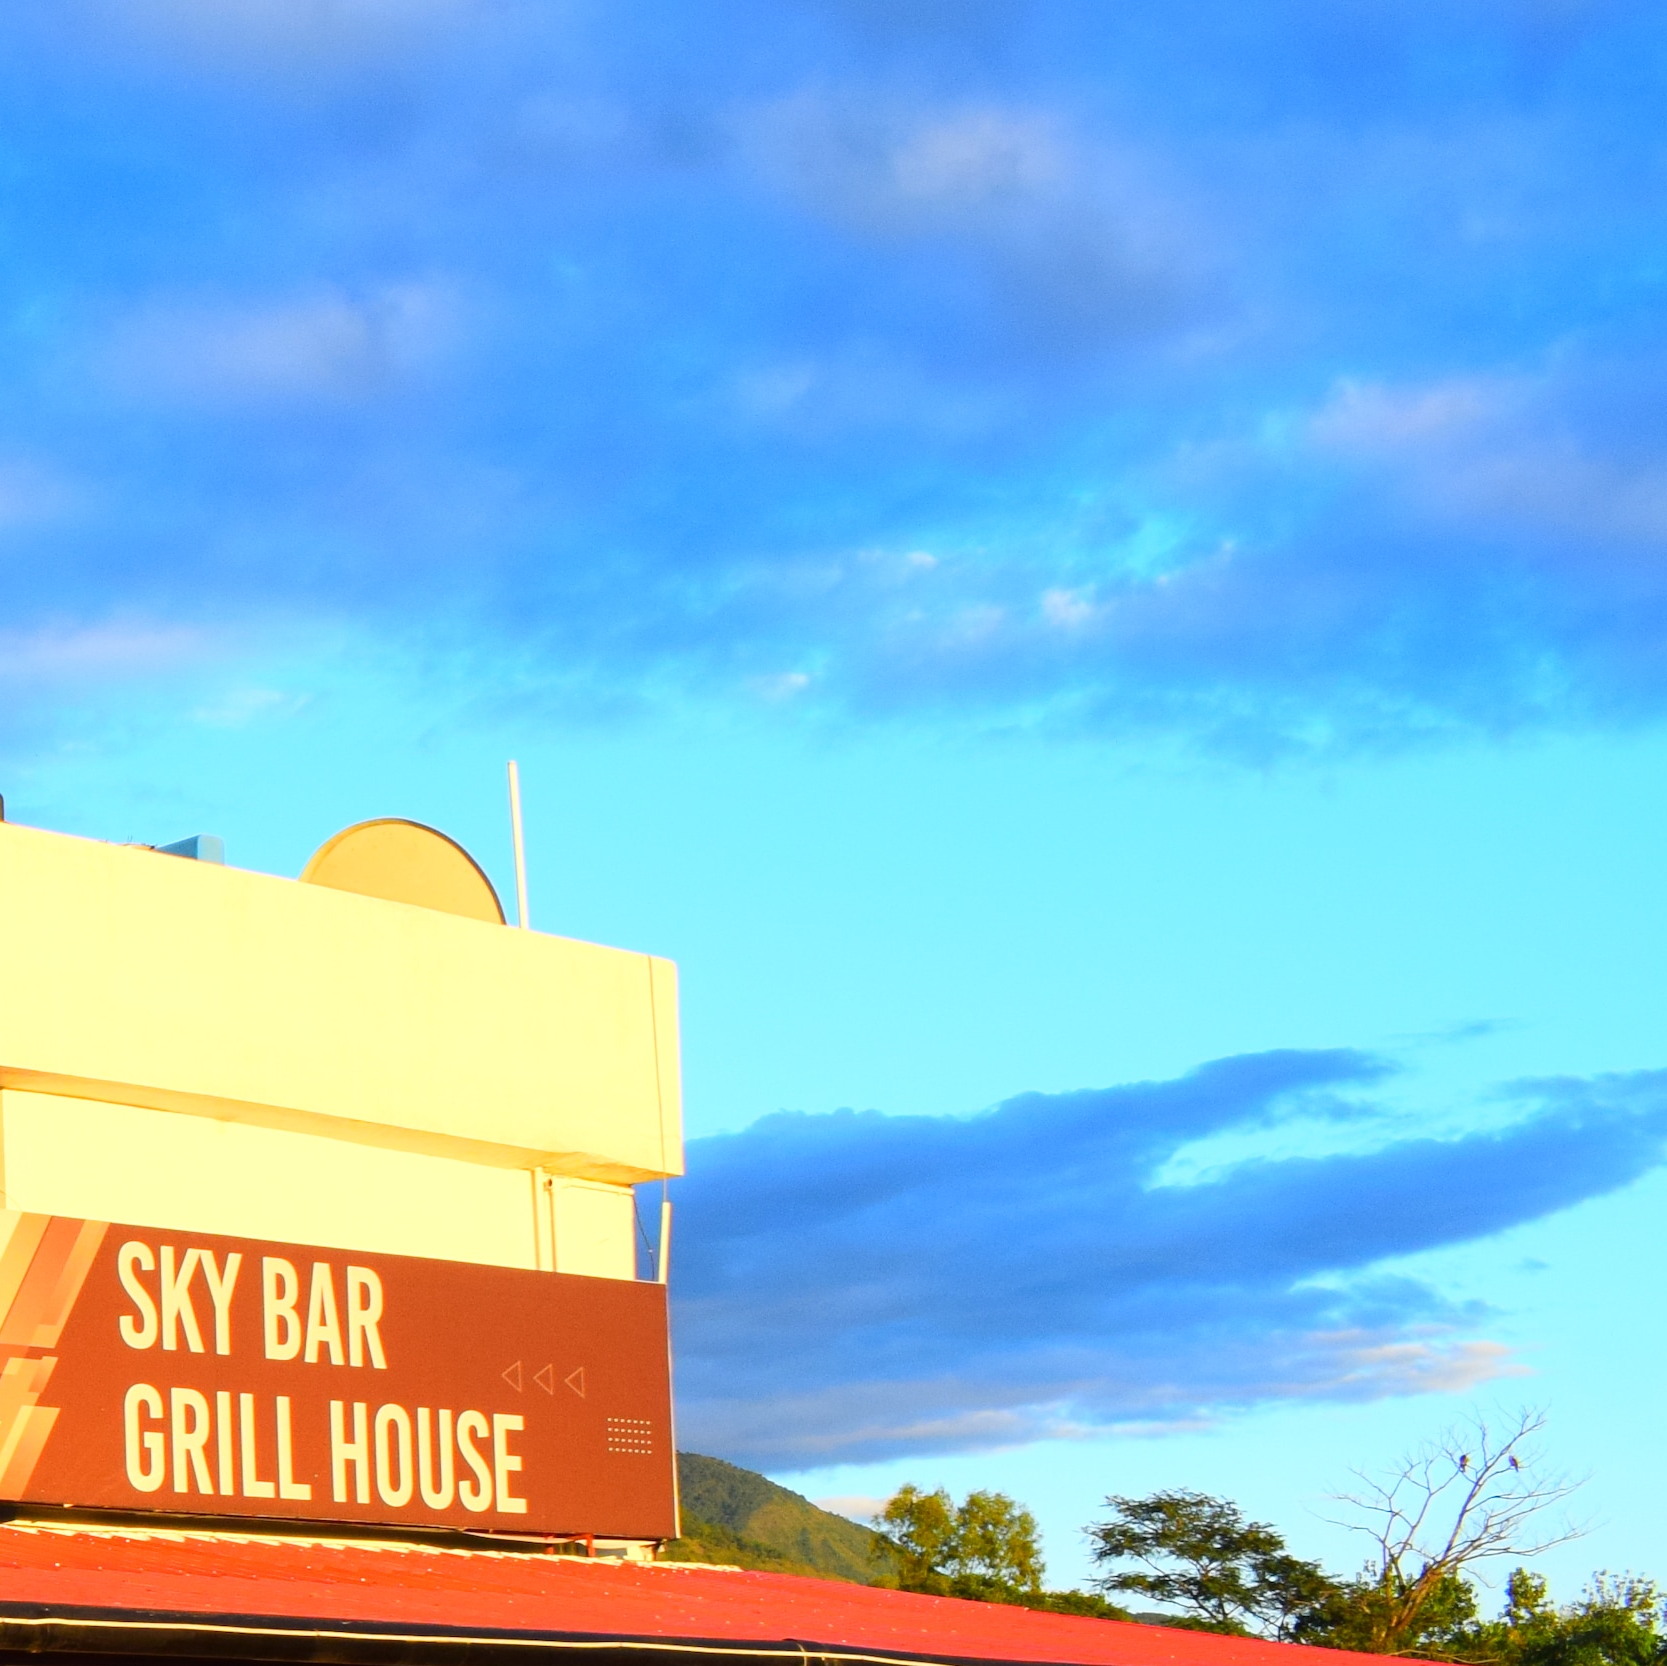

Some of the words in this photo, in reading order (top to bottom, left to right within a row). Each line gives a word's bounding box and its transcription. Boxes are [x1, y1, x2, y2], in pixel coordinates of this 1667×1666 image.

[117, 1240, 243, 1356] SKY
[262, 1256, 388, 1370] BAR
[123, 1382, 312, 1501] GRILL
[329, 1399, 528, 1514] HOUSE
